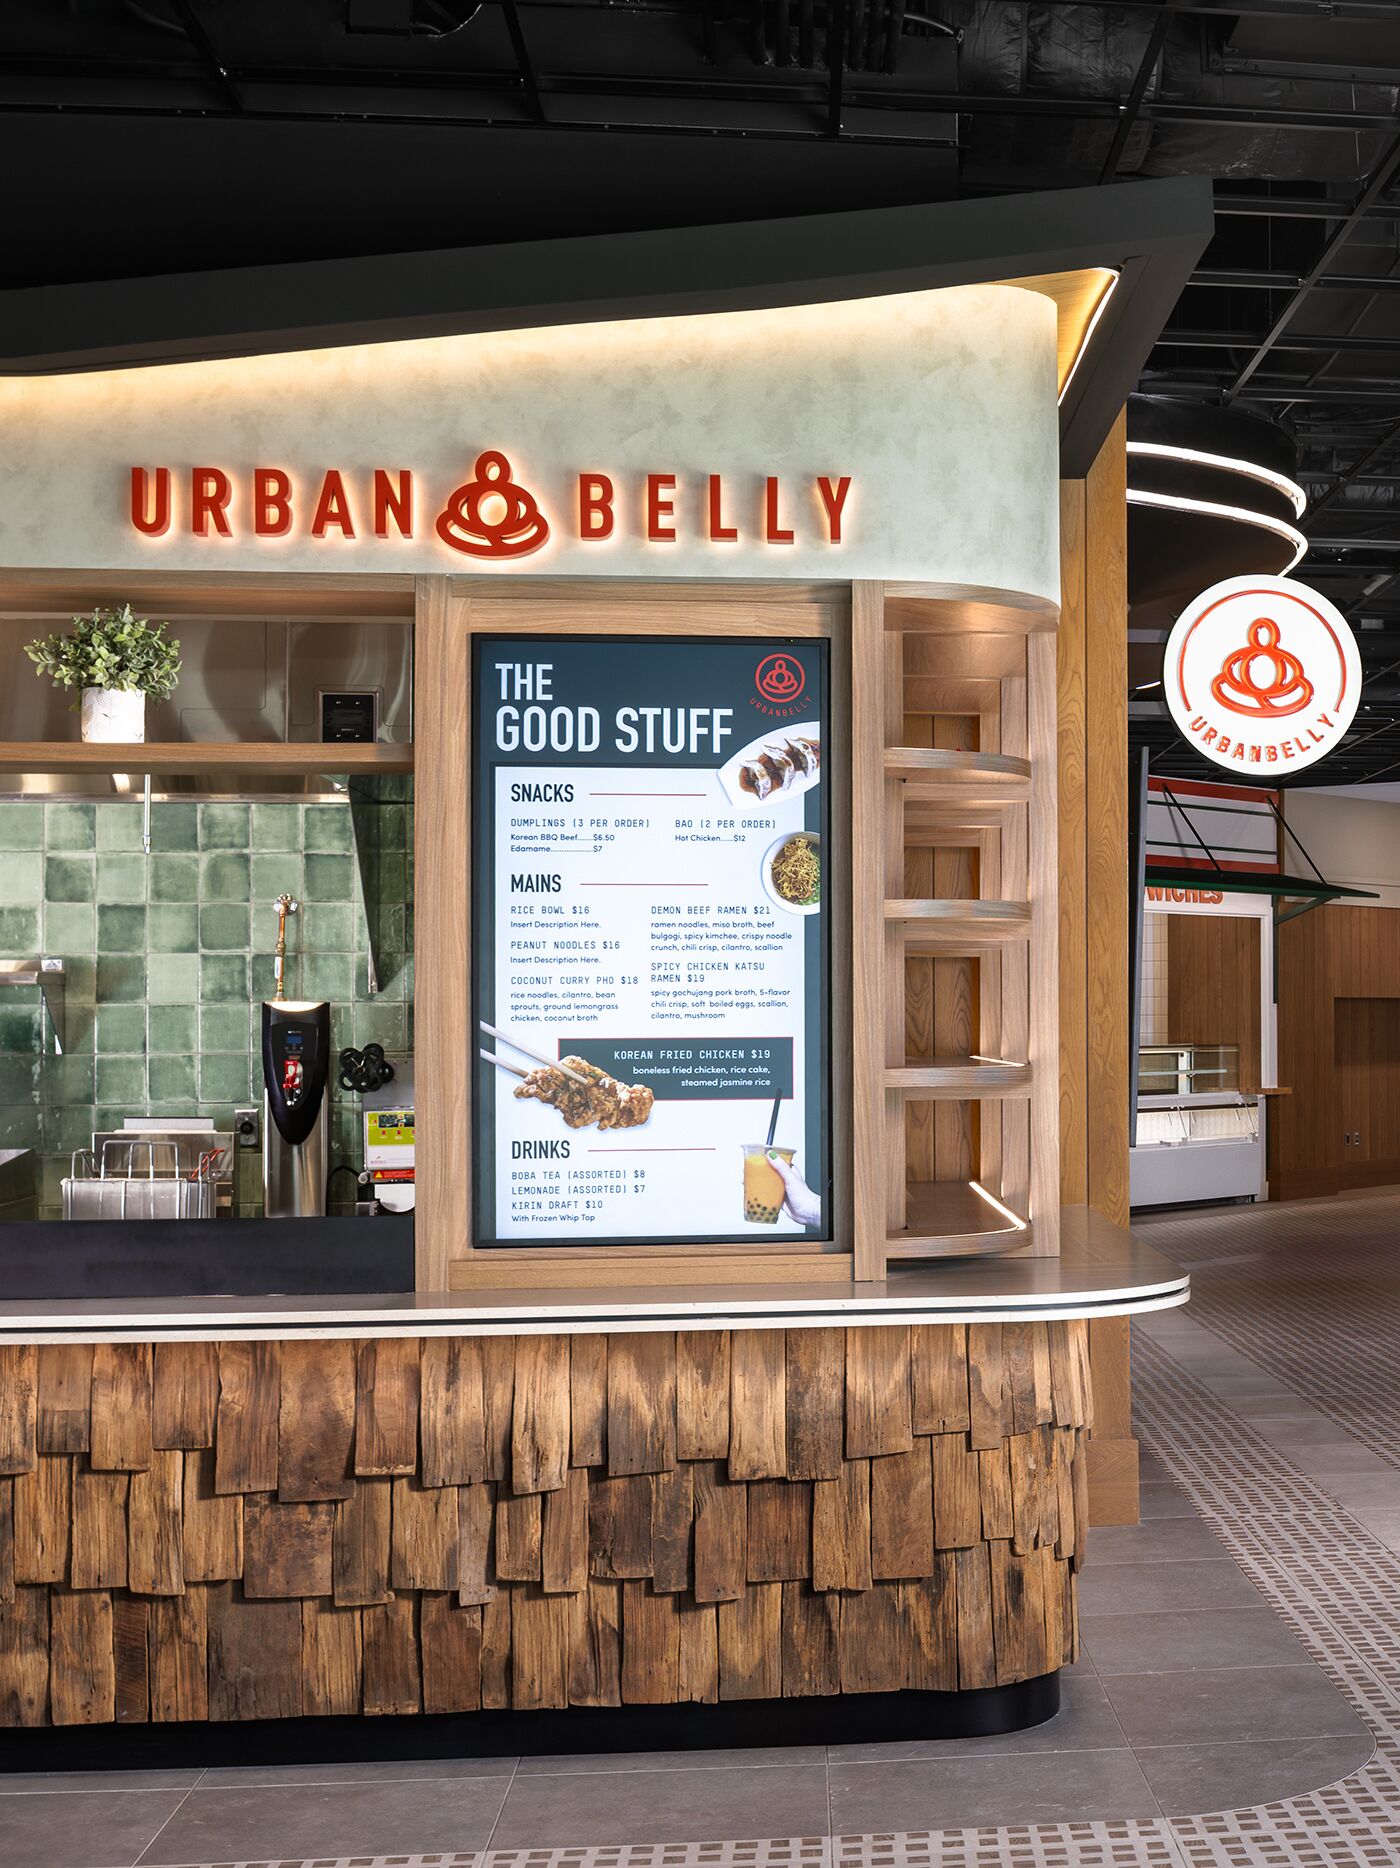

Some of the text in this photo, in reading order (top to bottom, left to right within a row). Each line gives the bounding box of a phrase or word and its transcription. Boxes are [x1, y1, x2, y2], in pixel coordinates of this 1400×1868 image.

[130, 466, 851, 545] URBAN BELLY
[495, 663, 554, 701] THE
[749, 695, 812, 717] URBANBELLY
[496, 705, 734, 753] GOOD STUFF
[1188, 713, 1335, 763] URBANBELLY
[511, 784, 574, 802] SNACKS
[510, 818, 650, 829] DUMPLINGS (3 PER ORDER)
[675, 820, 776, 829] BAO (2 PER ORDER)
[510, 833, 538, 841] Korean
[540, 833, 558, 841] BBQ
[675, 834, 688, 842] Hot
[511, 874, 562, 893] MAINS
[510, 906, 590, 915] RICE BOWL $16
[651, 906, 771, 915] DEMON BEEF RAMEN $21
[534, 921, 579, 930] Description
[678, 921, 711, 929] noodles,
[732, 921, 756, 929] broth,
[651, 932, 792, 941] bulgogi, spicy kimchee, crispy noodle
[510, 941, 621, 950] PEANUT NOODLES $16
[651, 944, 680, 952] crunch,
[699, 944, 719, 952] crisp,
[721, 944, 753, 952] cilantro,
[510, 956, 601, 965] Insert Description Here.
[651, 962, 765, 971] SPICY CHICKEN KATSU
[511, 976, 639, 985] COCONUT CURRY PHO $18
[651, 974, 705, 983] RAMEN $19
[651, 989, 670, 997] spicy
[672, 989, 713, 997] gochujang
[715, 989, 732, 997] pork
[511, 1003, 619, 1011] sprouts, ground lemongrass
[651, 1000, 789, 1009] chili crisp, soft boiled eggs, scallion,
[511, 1014, 598, 1022] chicken, coconut broth
[614, 1050, 771, 1060] KOREAN FRIED CHICKEN $19
[633, 1066, 771, 1075] boneless fried chicken, rice cake,
[719, 1079, 753, 1088] jasmine
[511, 1140, 570, 1159] DRINKS
[511, 1170, 646, 1180] BOBA TEA (ASSORTED) $8
[511, 1184, 646, 1195] LEMONADE (ASSORTED) $7
[512, 1200, 603, 1210] KIRIN DRAFT $10
[511, 1214, 596, 1222] With Frozen Whip Top
